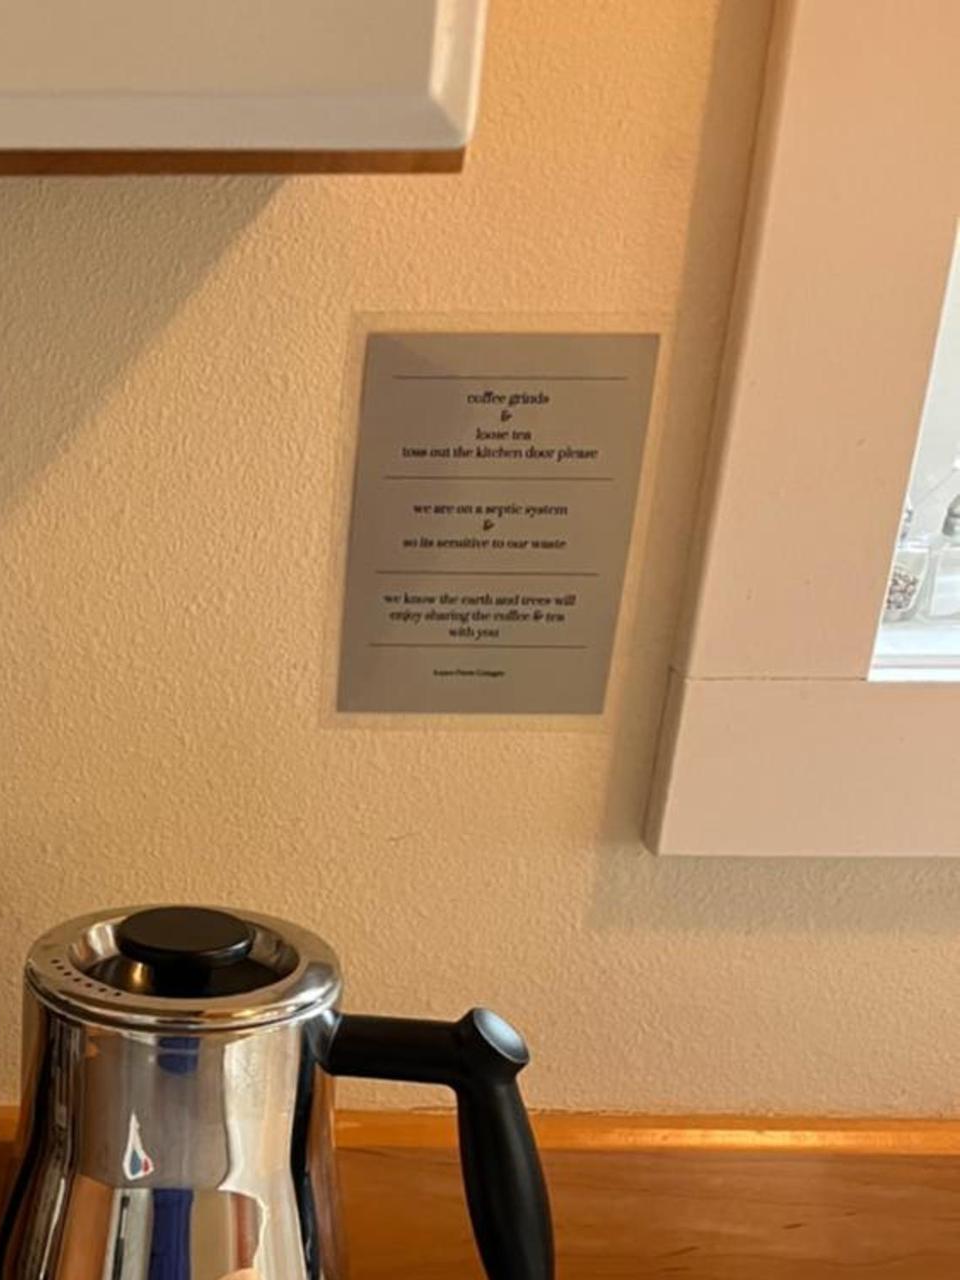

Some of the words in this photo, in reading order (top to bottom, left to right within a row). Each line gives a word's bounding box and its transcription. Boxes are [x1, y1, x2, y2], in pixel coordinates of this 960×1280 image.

[467, 391, 507, 405] coffee
[508, 393, 551, 406] grinds
[500, 409, 513, 422] &
[476, 428, 509, 440] loose
[512, 429, 532, 440] tea
[430, 447, 451, 458] out
[452, 446, 473, 458] the
[475, 446, 523, 458] kitchen
[525, 446, 554, 458] door
[556, 446, 599, 463] please
[413, 504, 433, 514] we
[433, 504, 455, 514] are
[456, 504, 473, 514] on
[475, 504, 484, 514] a
[485, 503, 523, 518] septic
[524, 504, 568, 519] system
[436, 537, 490, 548] sensitive
[492, 538, 505, 548] to
[506, 539, 529, 549] our
[531, 539, 567, 549] waste
[383, 595, 402, 604] we
[403, 592, 436, 604] know
[439, 592, 457, 605] the
[461, 593, 493, 605] earth
[495, 594, 519, 606] and
[521, 595, 551, 606] trees
[555, 594, 577, 606] will
[389, 611, 422, 625] enjoy
[424, 610, 470, 623] sharing
[471, 611, 490, 622] the
[493, 610, 530, 622] coffee
[545, 612, 565, 622] tea
[449, 627, 475, 638] with
